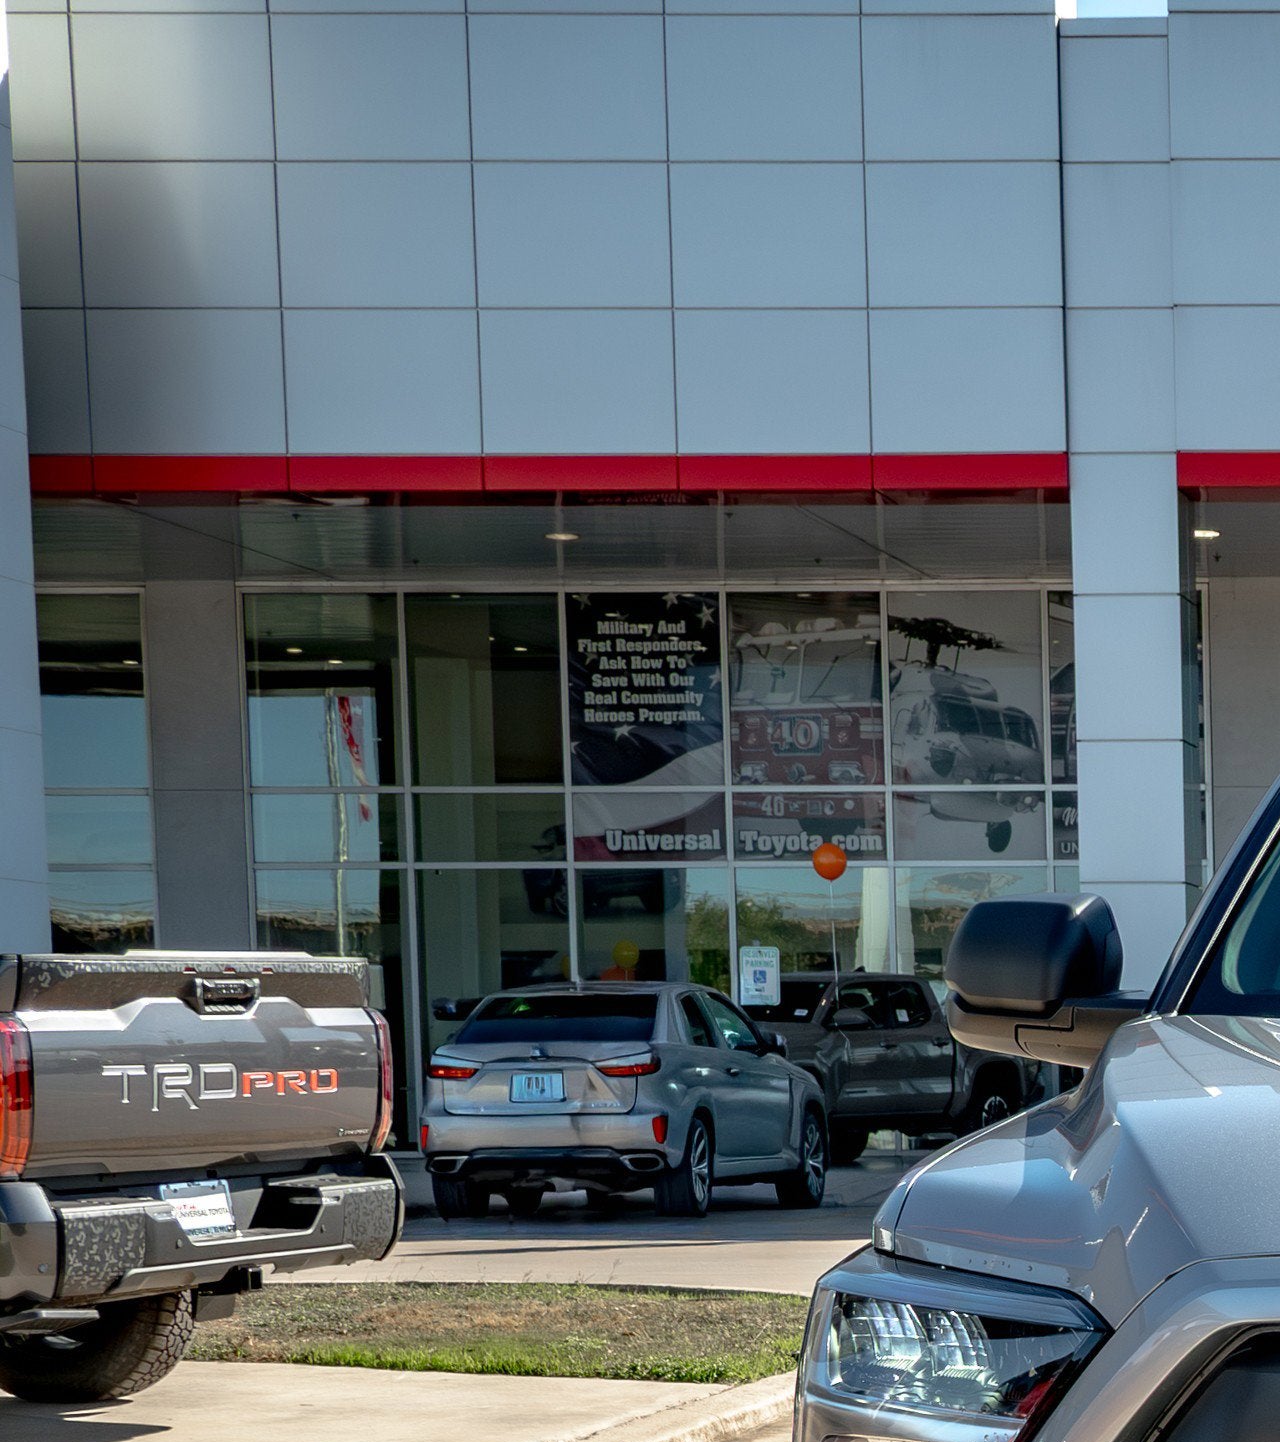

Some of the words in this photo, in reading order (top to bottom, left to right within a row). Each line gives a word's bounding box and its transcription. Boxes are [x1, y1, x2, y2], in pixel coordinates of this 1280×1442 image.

[596, 620, 654, 637] Military
[657, 620, 686, 634] And
[577, 639, 612, 653] First
[599, 656, 627, 670] Ask
[630, 656, 663, 670] How
[666, 655, 687, 669] To
[591, 674, 629, 688] Save
[632, 673, 665, 687] With
[669, 673, 695, 687] Our
[584, 691, 618, 705] Real
[621, 690, 704, 707] Community
[584, 709, 635, 723] Heroes
[638, 708, 705, 725] Program.
[605, 828, 721, 851] Universal
[739, 830, 883, 857] Toyotacom
[101, 1062, 238, 1112] TRD
[242, 1068, 340, 1098] PRO
